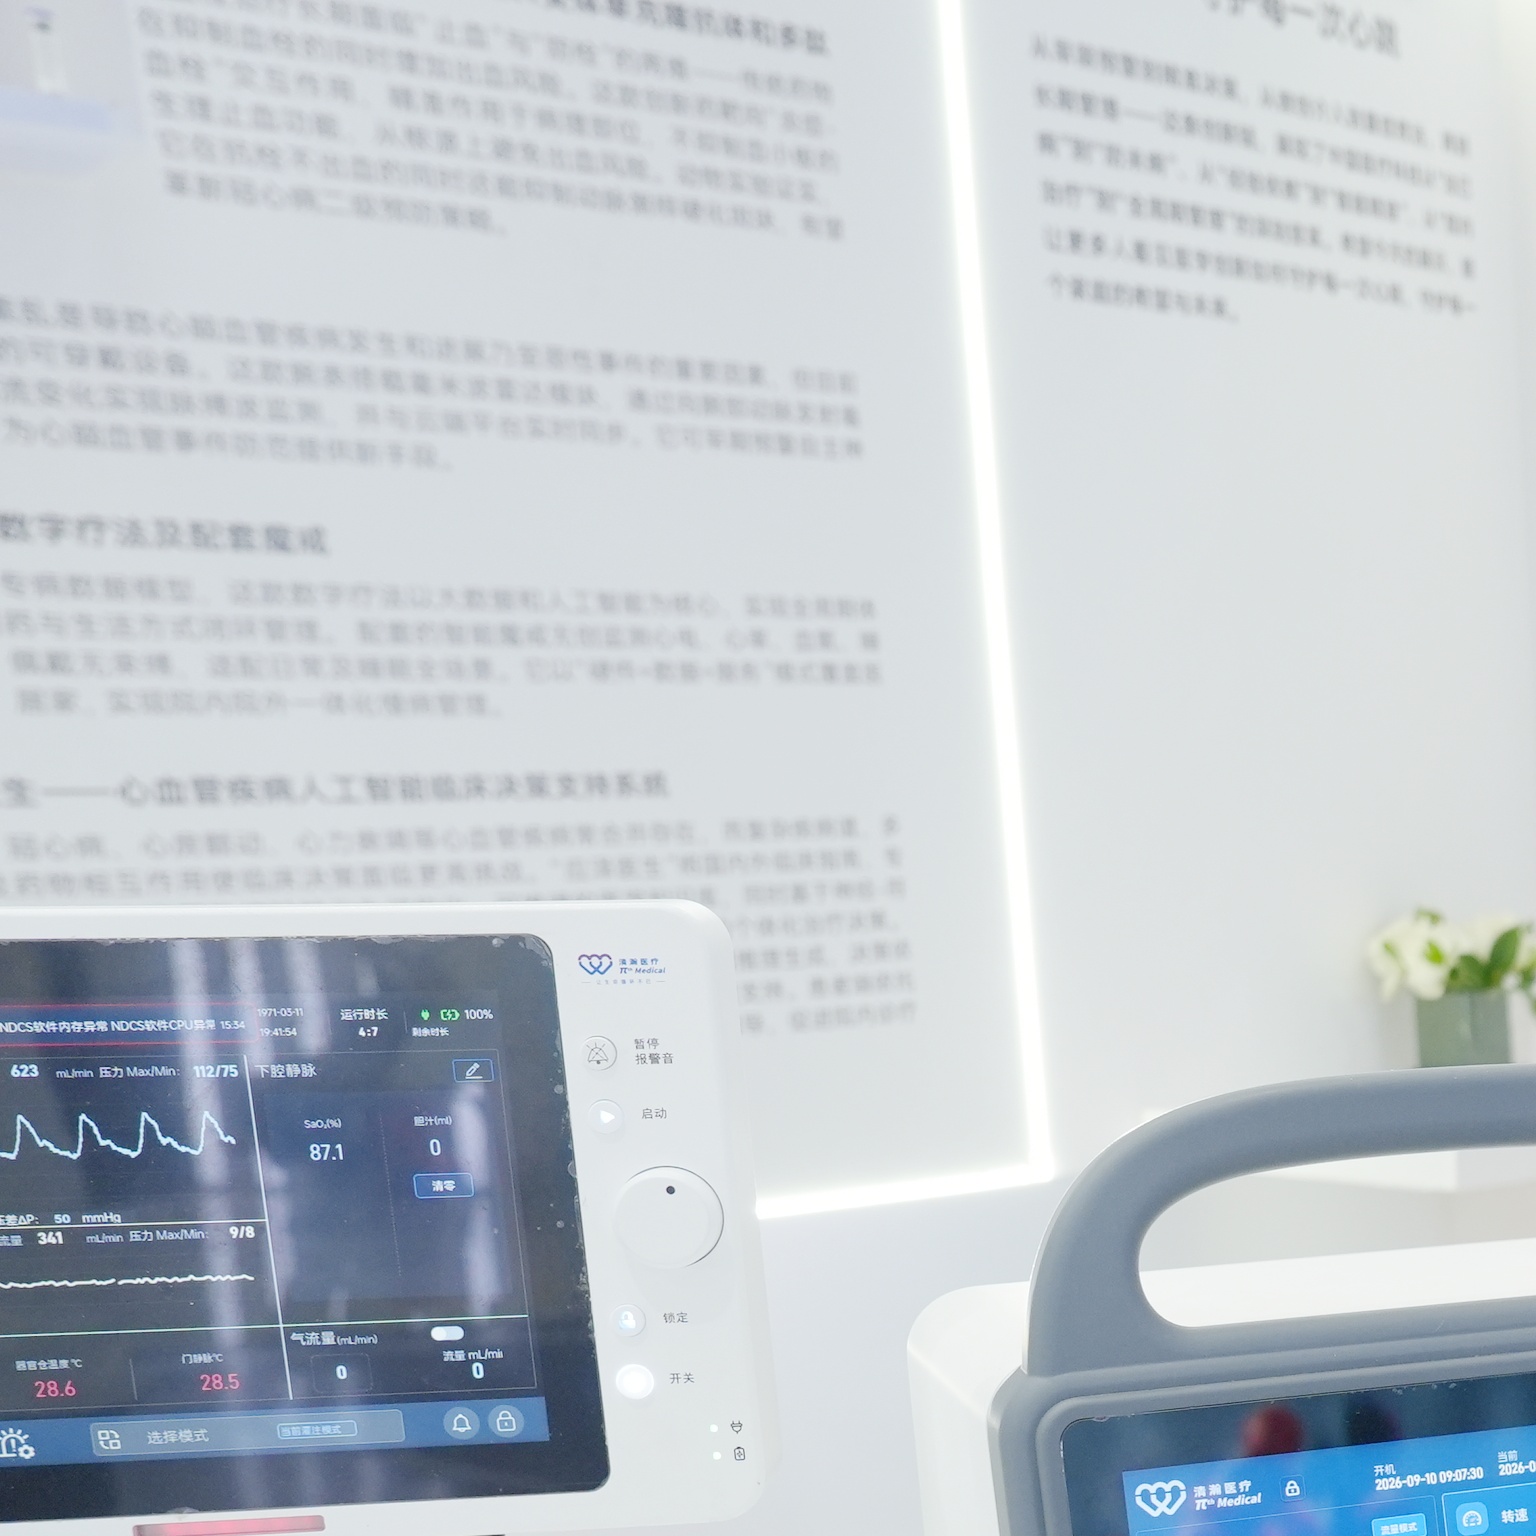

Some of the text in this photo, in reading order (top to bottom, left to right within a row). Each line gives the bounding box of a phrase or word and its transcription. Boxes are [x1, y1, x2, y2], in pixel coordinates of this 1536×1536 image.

[340, 1008, 388, 1021] 运行时长
[464, 1009, 493, 1020] 100%
[260, 1027, 297, 1037] 19:41:54
[358, 1026, 378, 1037] 4:7
[634, 1038, 659, 1050] 暂停
[635, 1053, 674, 1065] 报警音
[11, 1064, 39, 1078] 623
[99, 1066, 123, 1078] 压力
[193, 1065, 238, 1078] 112/75
[254, 1065, 317, 1078] 下腔静脉
[642, 1108, 667, 1119] 启动
[310, 1143, 343, 1161] 87.1
[430, 1139, 441, 1156] 0
[432, 1180, 456, 1192] 清零
[54, 1213, 71, 1224] 50
[38, 1232, 64, 1245] 341
[129, 1231, 153, 1242] 压力
[229, 1226, 255, 1239] 9/8
[663, 1312, 688, 1323] 锁定
[443, 1350, 466, 1362] 流量
[336, 1365, 347, 1380] 0
[472, 1362, 484, 1379] 0
[200, 1373, 240, 1391] 28.5
[670, 1372, 695, 1384] 开关
[35, 1380, 76, 1398] 28.6
[147, 1429, 209, 1444] 选择模式
[1498, 1450, 1518, 1463] 当前
[1374, 1464, 1396, 1476] 开机
[1375, 1467, 1483, 1491] 2026-09-10 09:07:30
[1193, 1480, 1251, 1498] 清瀚医疗
[1217, 1493, 1262, 1508] Medical
[1501, 1508, 1528, 1523] 转速
